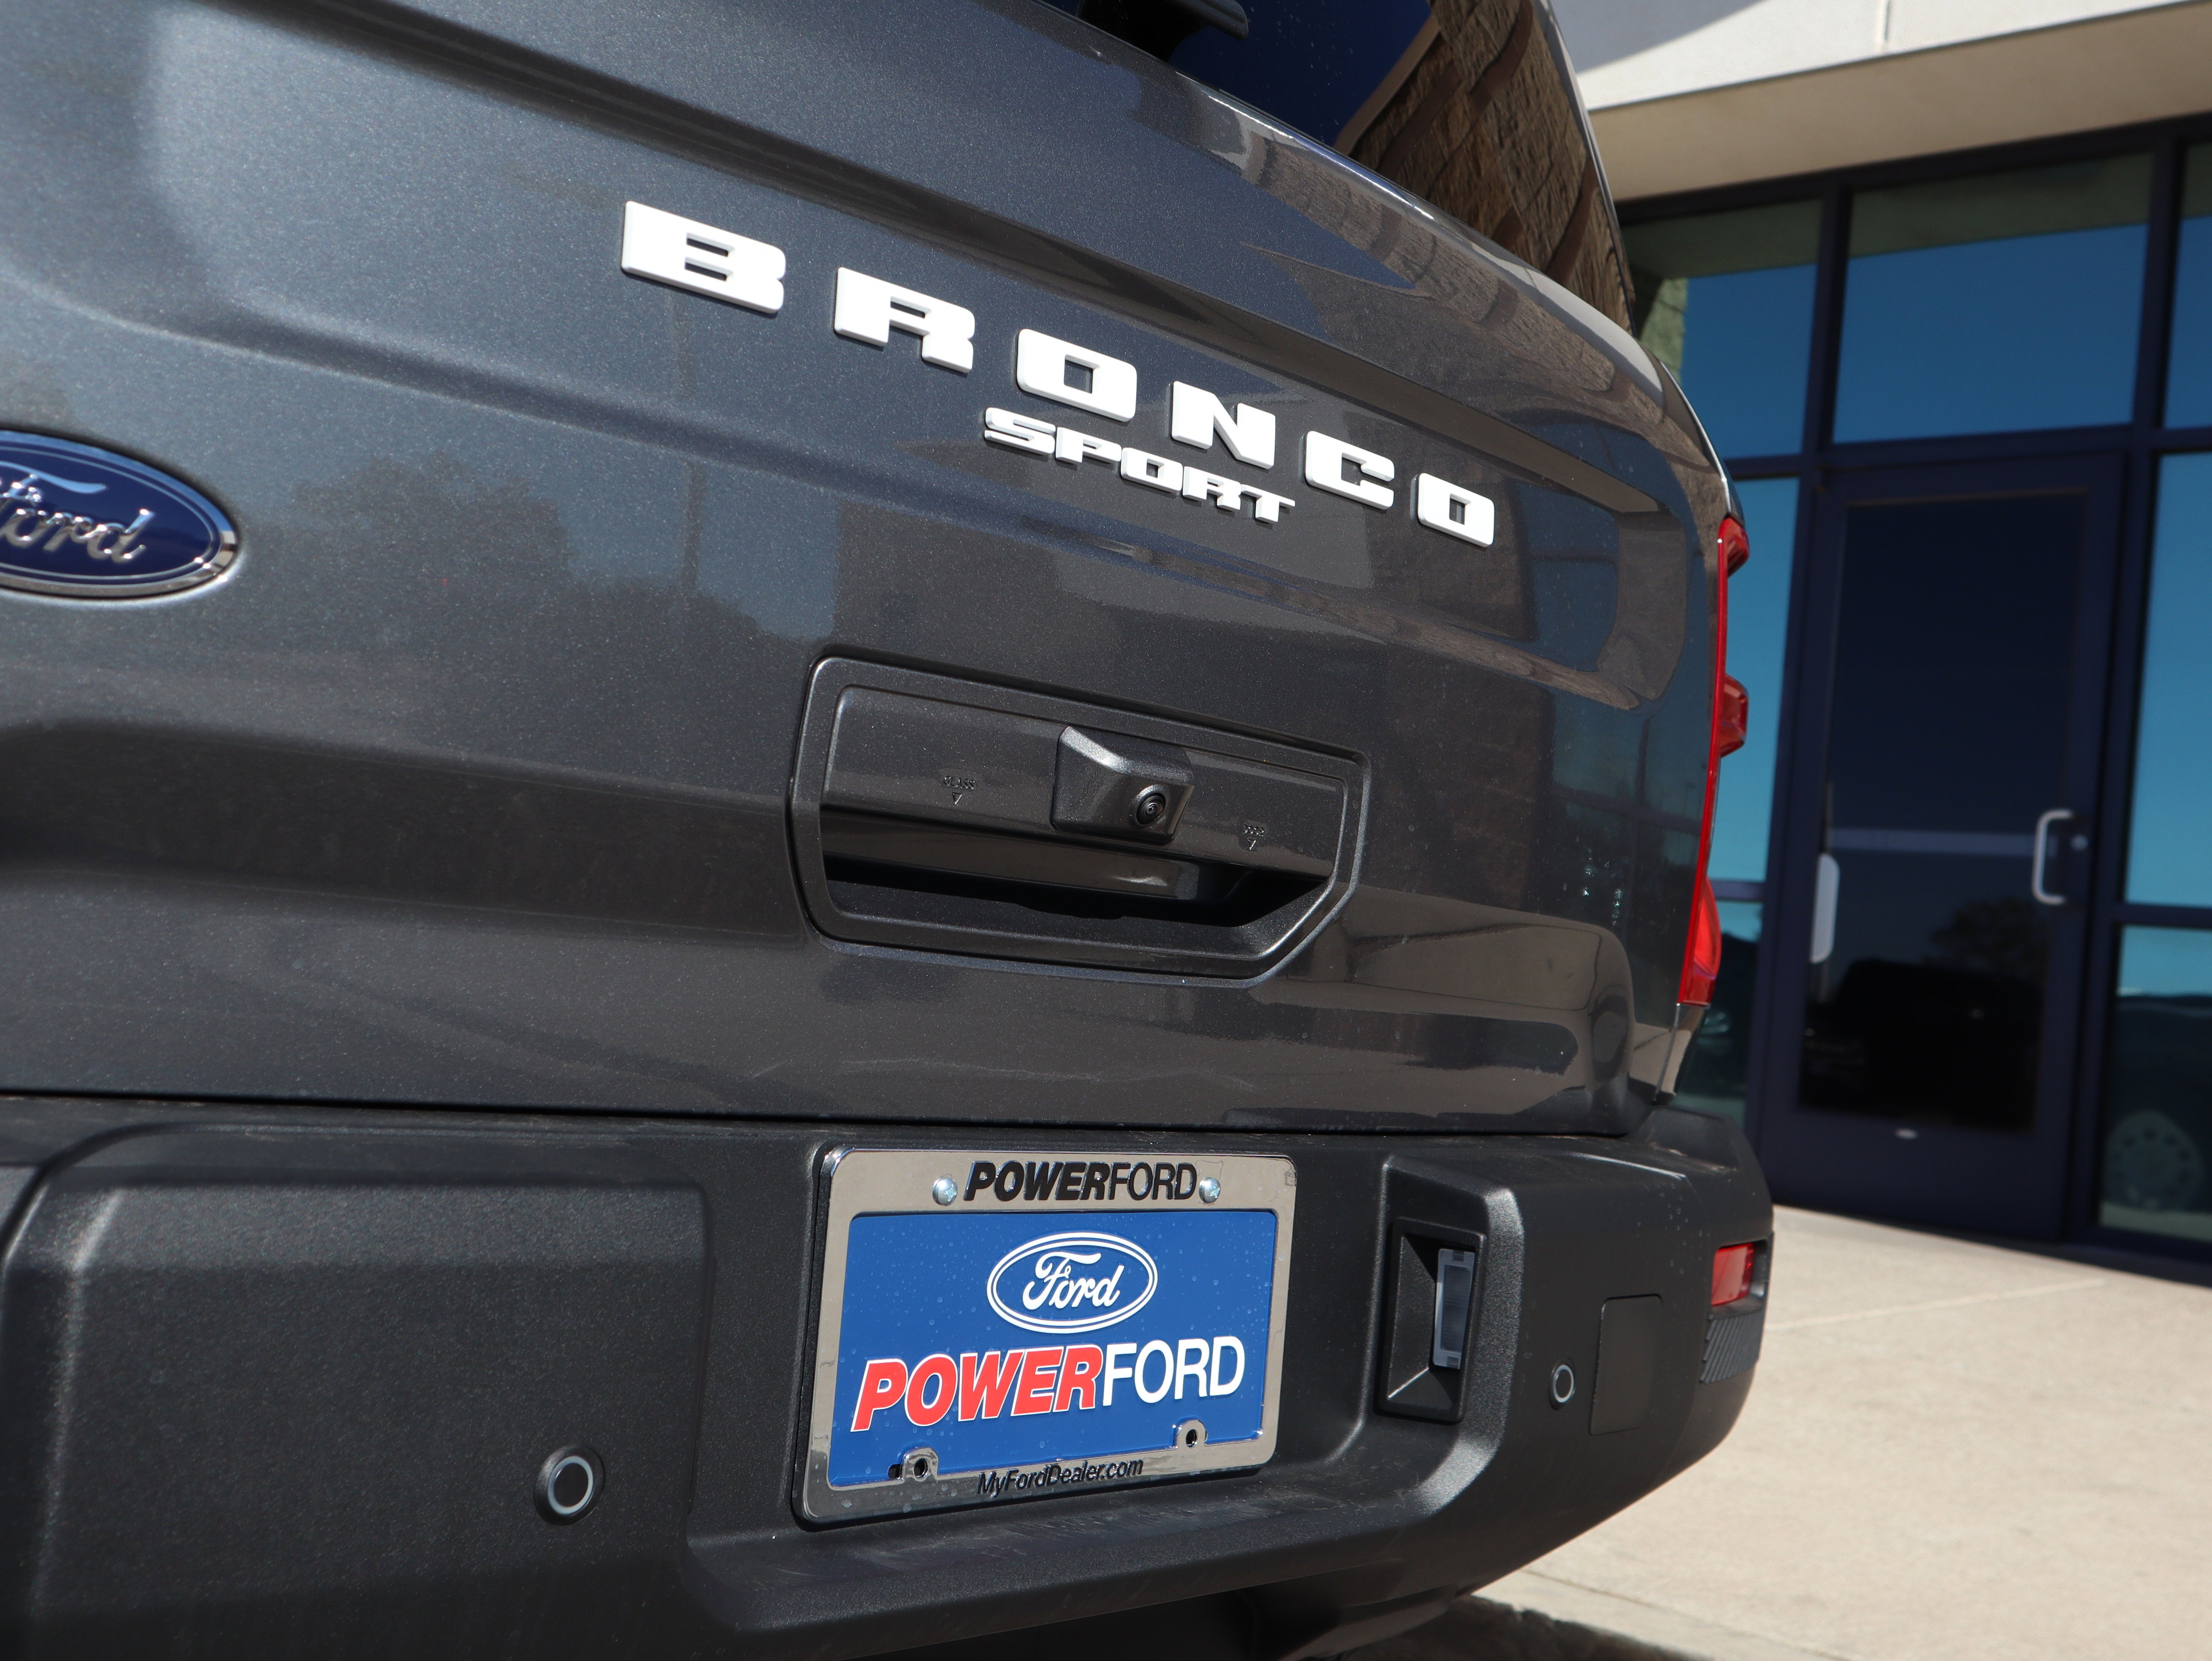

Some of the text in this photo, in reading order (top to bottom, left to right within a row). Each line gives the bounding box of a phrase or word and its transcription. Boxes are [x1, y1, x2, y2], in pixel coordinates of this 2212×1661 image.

[623, 201, 1495, 546] BRONCO
[984, 407, 1295, 522] SPORT
[944, 776, 976, 789] GLASS
[964, 1161, 1197, 1201] POWERFORD
[1023, 1252, 1125, 1310] Ford
[851, 1336, 1245, 1432] POWERFORD
[977, 1459, 1144, 1498] MyFordDealer.com
